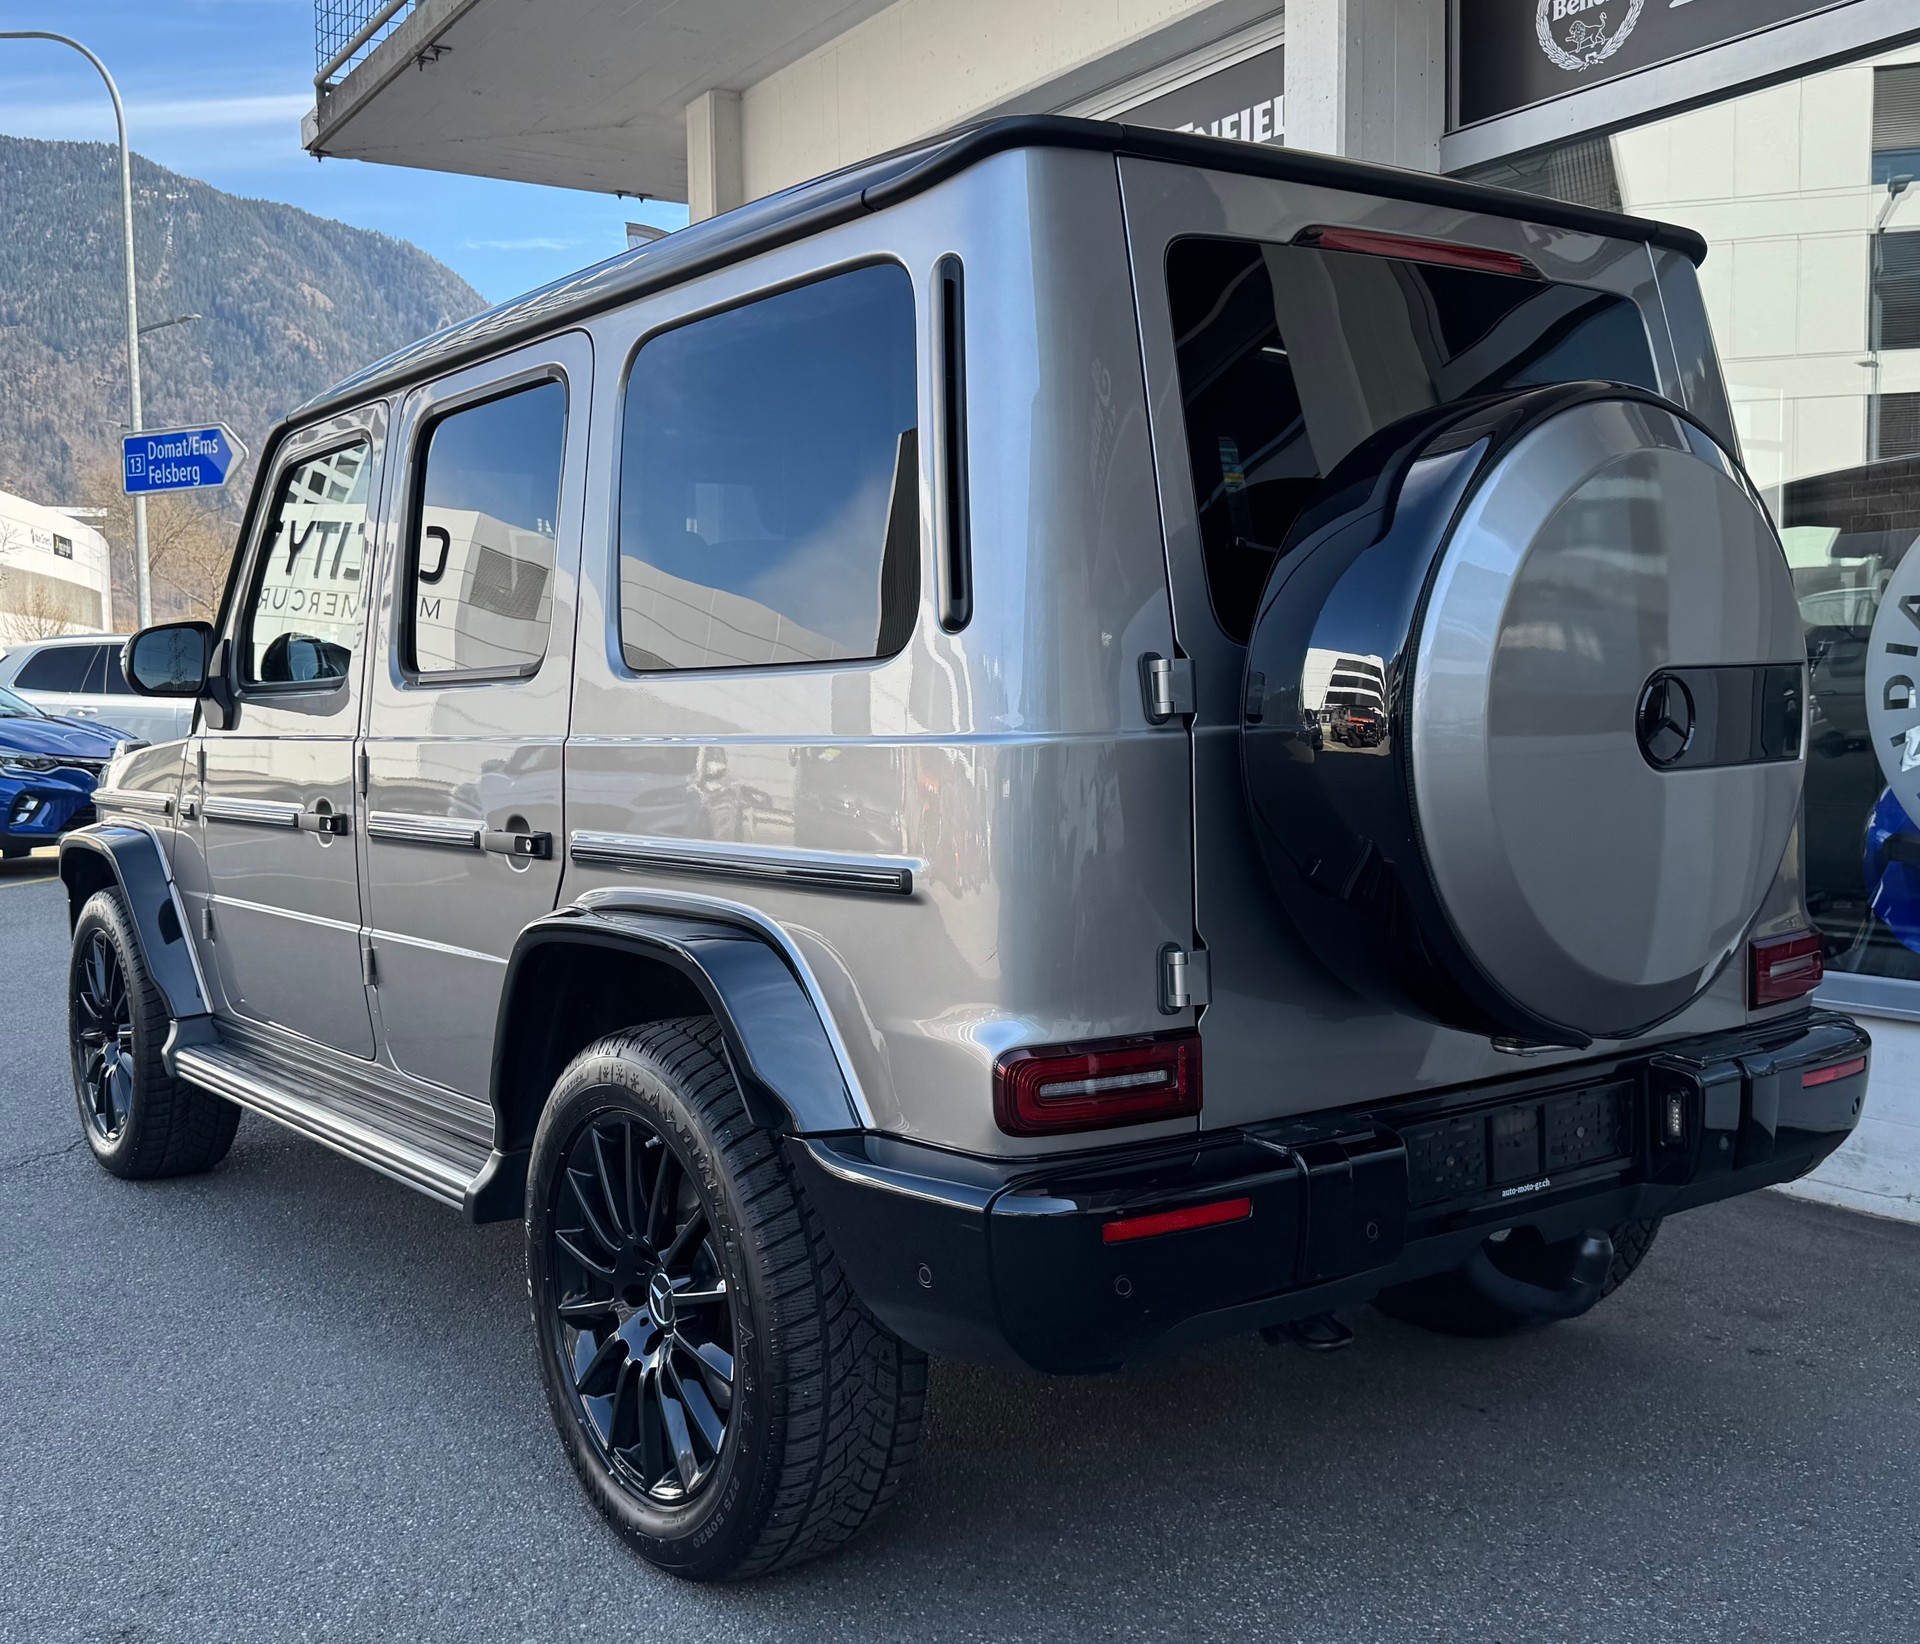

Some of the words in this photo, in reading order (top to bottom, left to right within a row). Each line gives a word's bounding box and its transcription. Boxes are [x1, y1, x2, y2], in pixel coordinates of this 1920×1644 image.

[1552, 0, 1610, 21] Ben
[1173, 95, 1285, 143] FIEL
[147, 436, 219, 460] Domat/Ems
[130, 457, 142, 473] 13
[148, 462, 201, 486] Felsberg
[723, 1476, 741, 1512] 275
